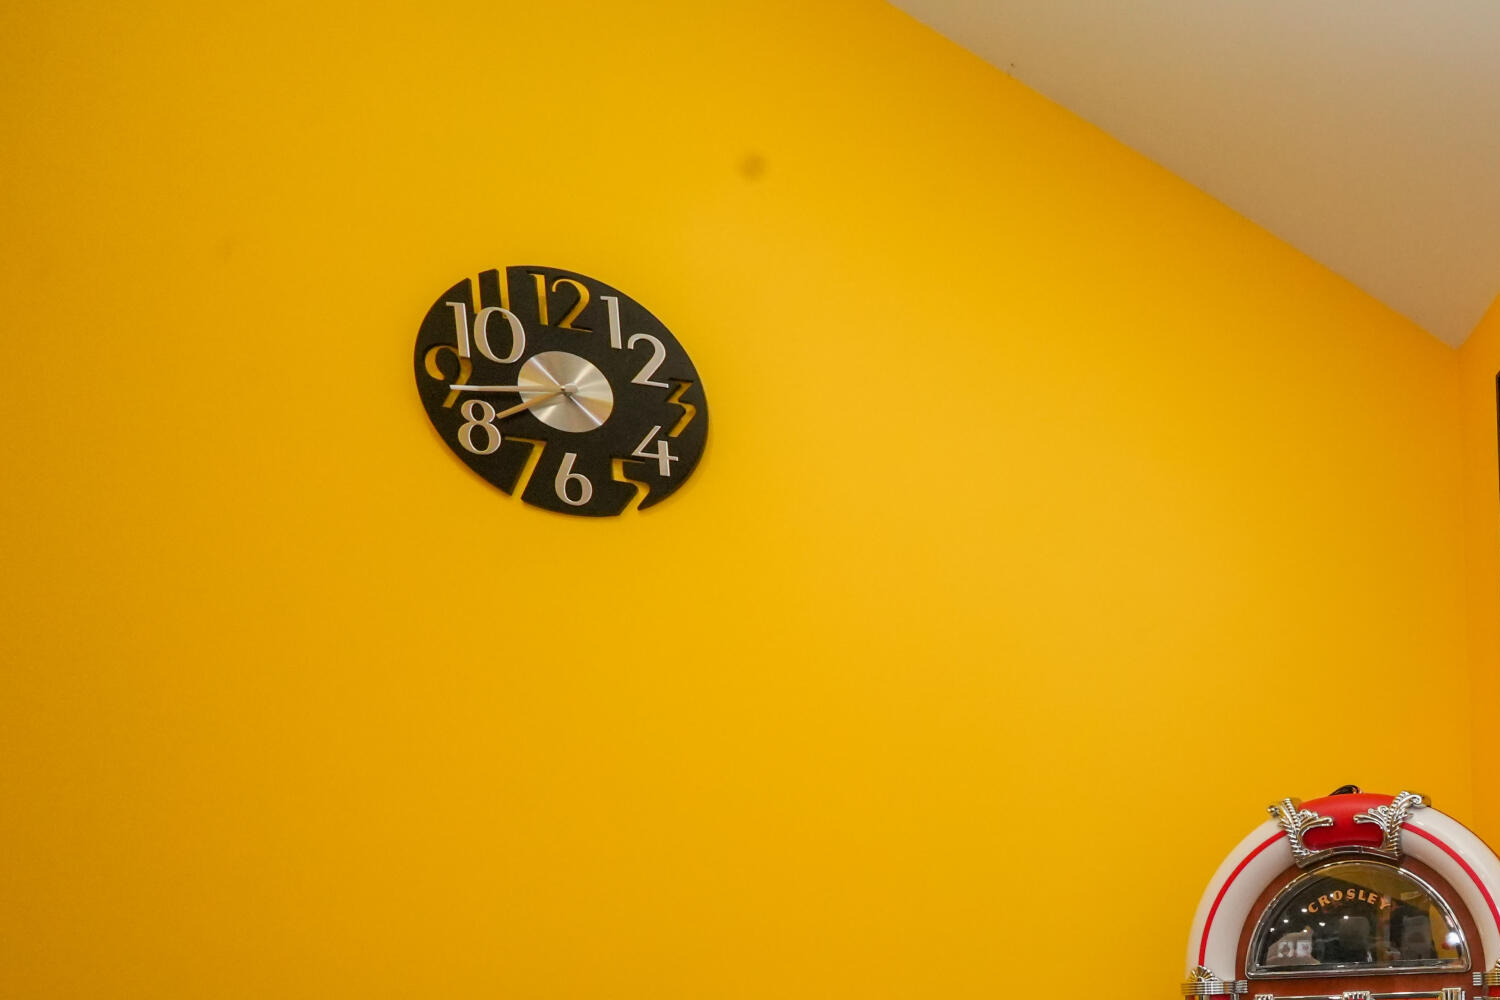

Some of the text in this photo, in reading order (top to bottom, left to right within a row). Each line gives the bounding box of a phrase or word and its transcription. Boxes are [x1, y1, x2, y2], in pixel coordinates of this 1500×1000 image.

[527, 270, 593, 333] 12
[446, 301, 526, 364] 10
[424, 342, 472, 409] 9
[457, 400, 501, 455] 8
[665, 377, 696, 438] 3
[503, 435, 548, 499] 7
[554, 452, 592, 506] 6
[631, 425, 679, 477] 4
[610, 454, 650, 514] 5
[1308, 888, 1391, 913] CROSLEY
